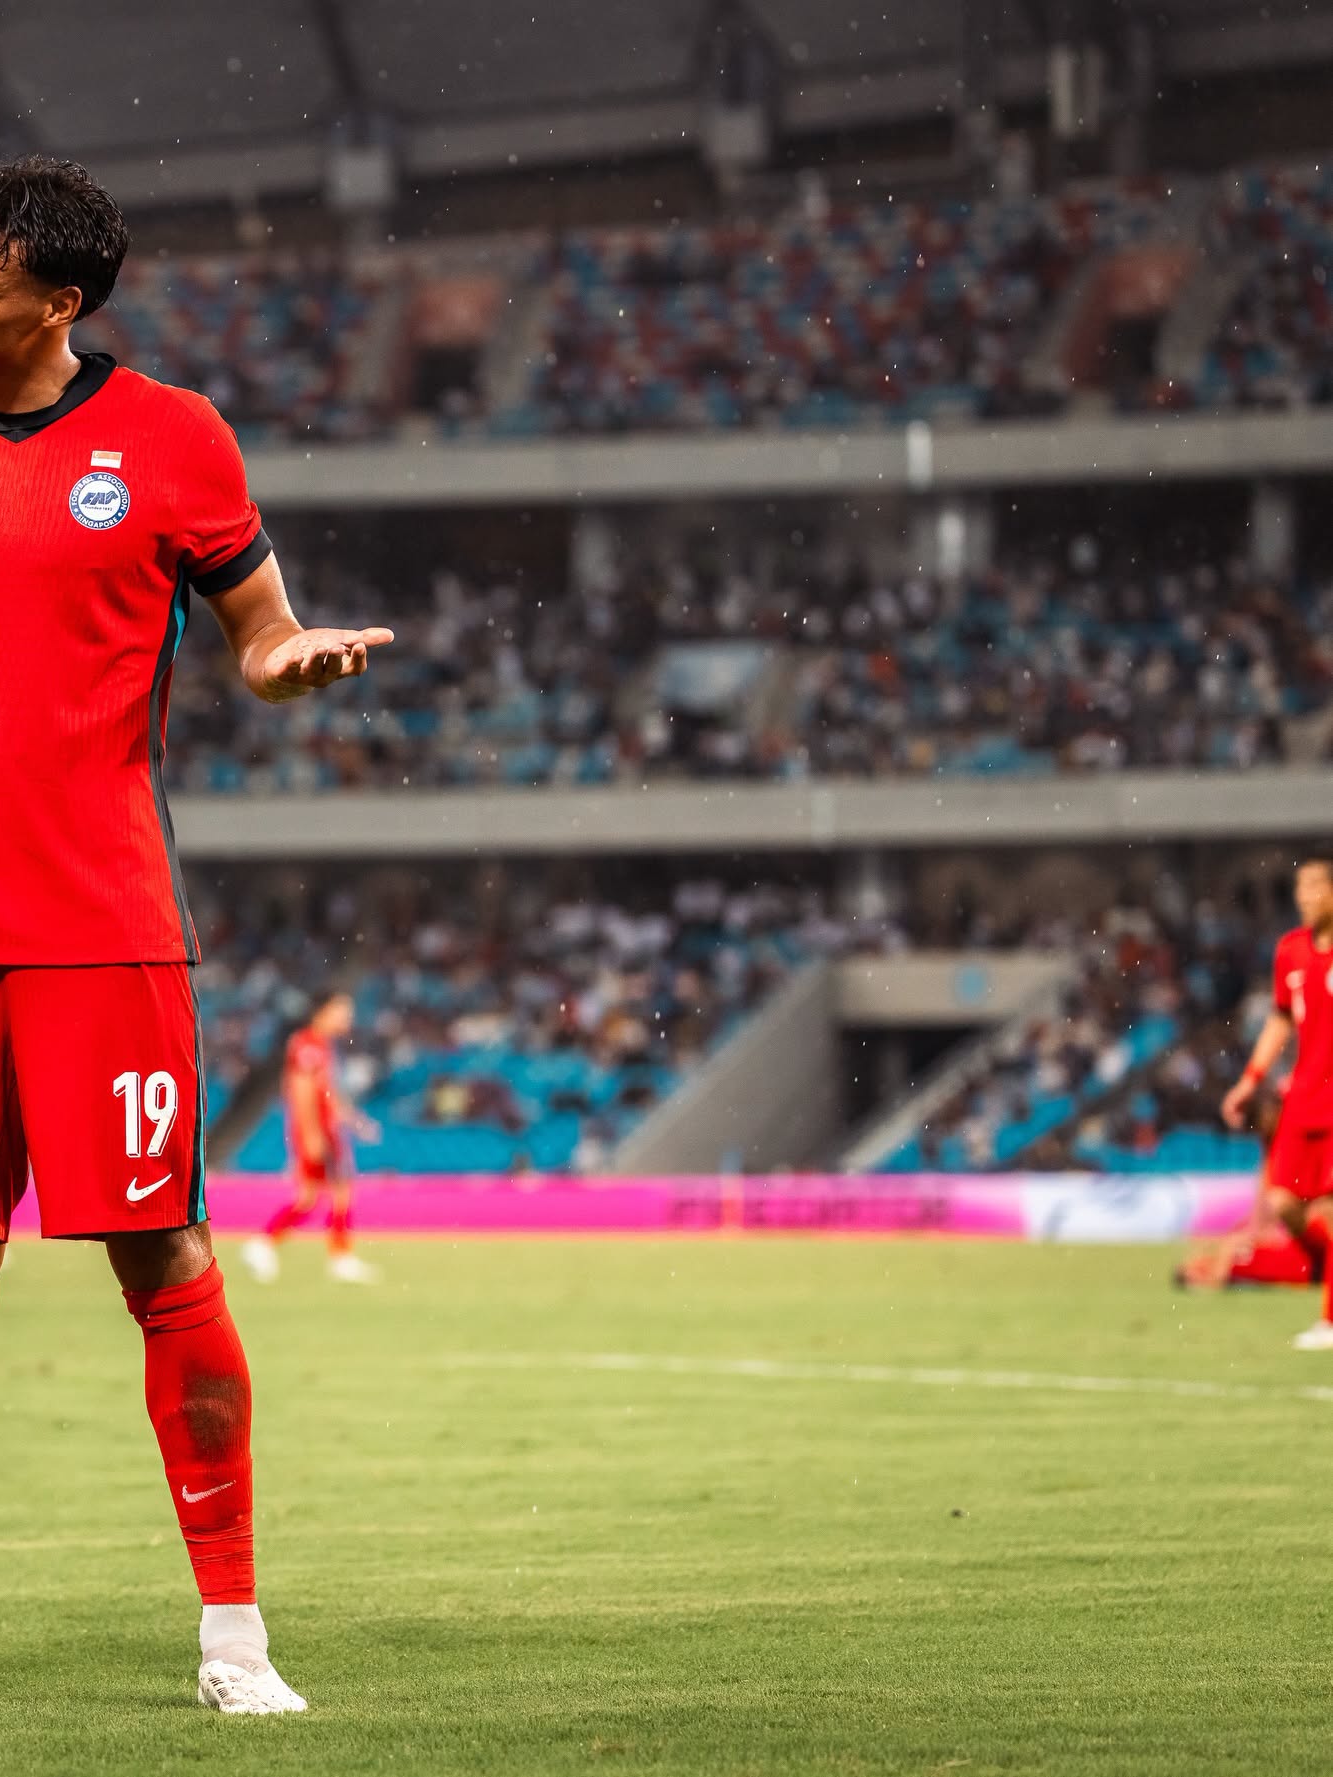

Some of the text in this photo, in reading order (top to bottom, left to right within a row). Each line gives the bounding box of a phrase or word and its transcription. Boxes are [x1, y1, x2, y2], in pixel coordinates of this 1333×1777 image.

[71, 474, 129, 511] FOOTBALL ASSOCIATION
[76, 513, 119, 528] SINGAPORE
[112, 1070, 179, 1158] 19
